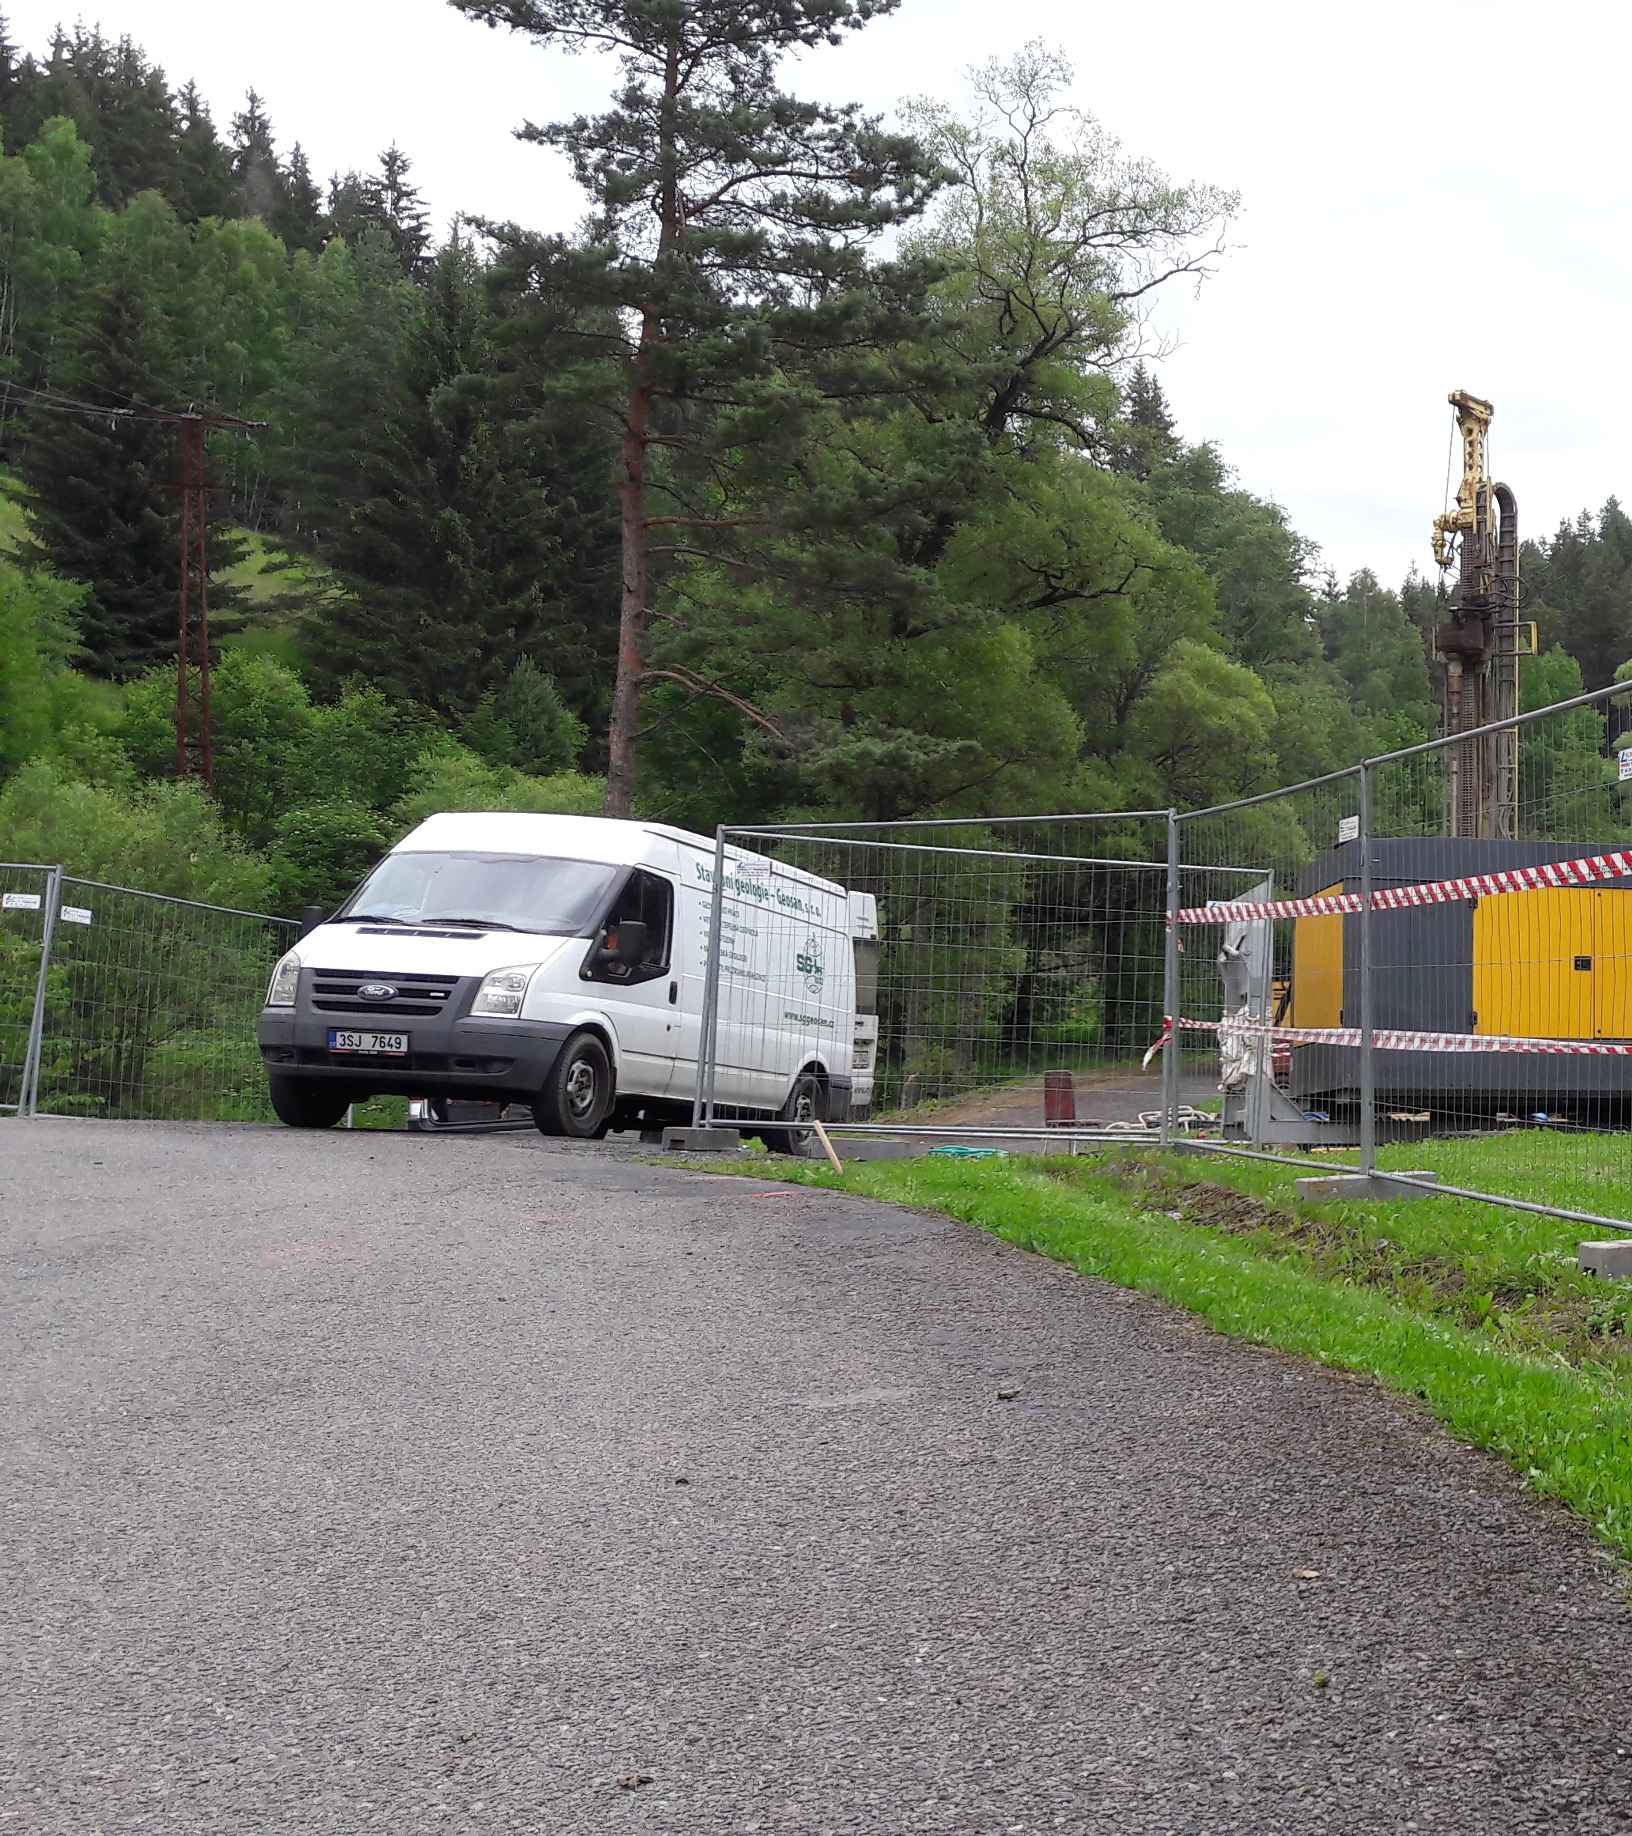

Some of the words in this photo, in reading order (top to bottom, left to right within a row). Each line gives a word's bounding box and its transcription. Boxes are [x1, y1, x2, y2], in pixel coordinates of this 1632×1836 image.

[736, 878, 769, 903] geologie
[339, 1033, 362, 1048] 3SJ
[371, 1035, 402, 1050] 7649
